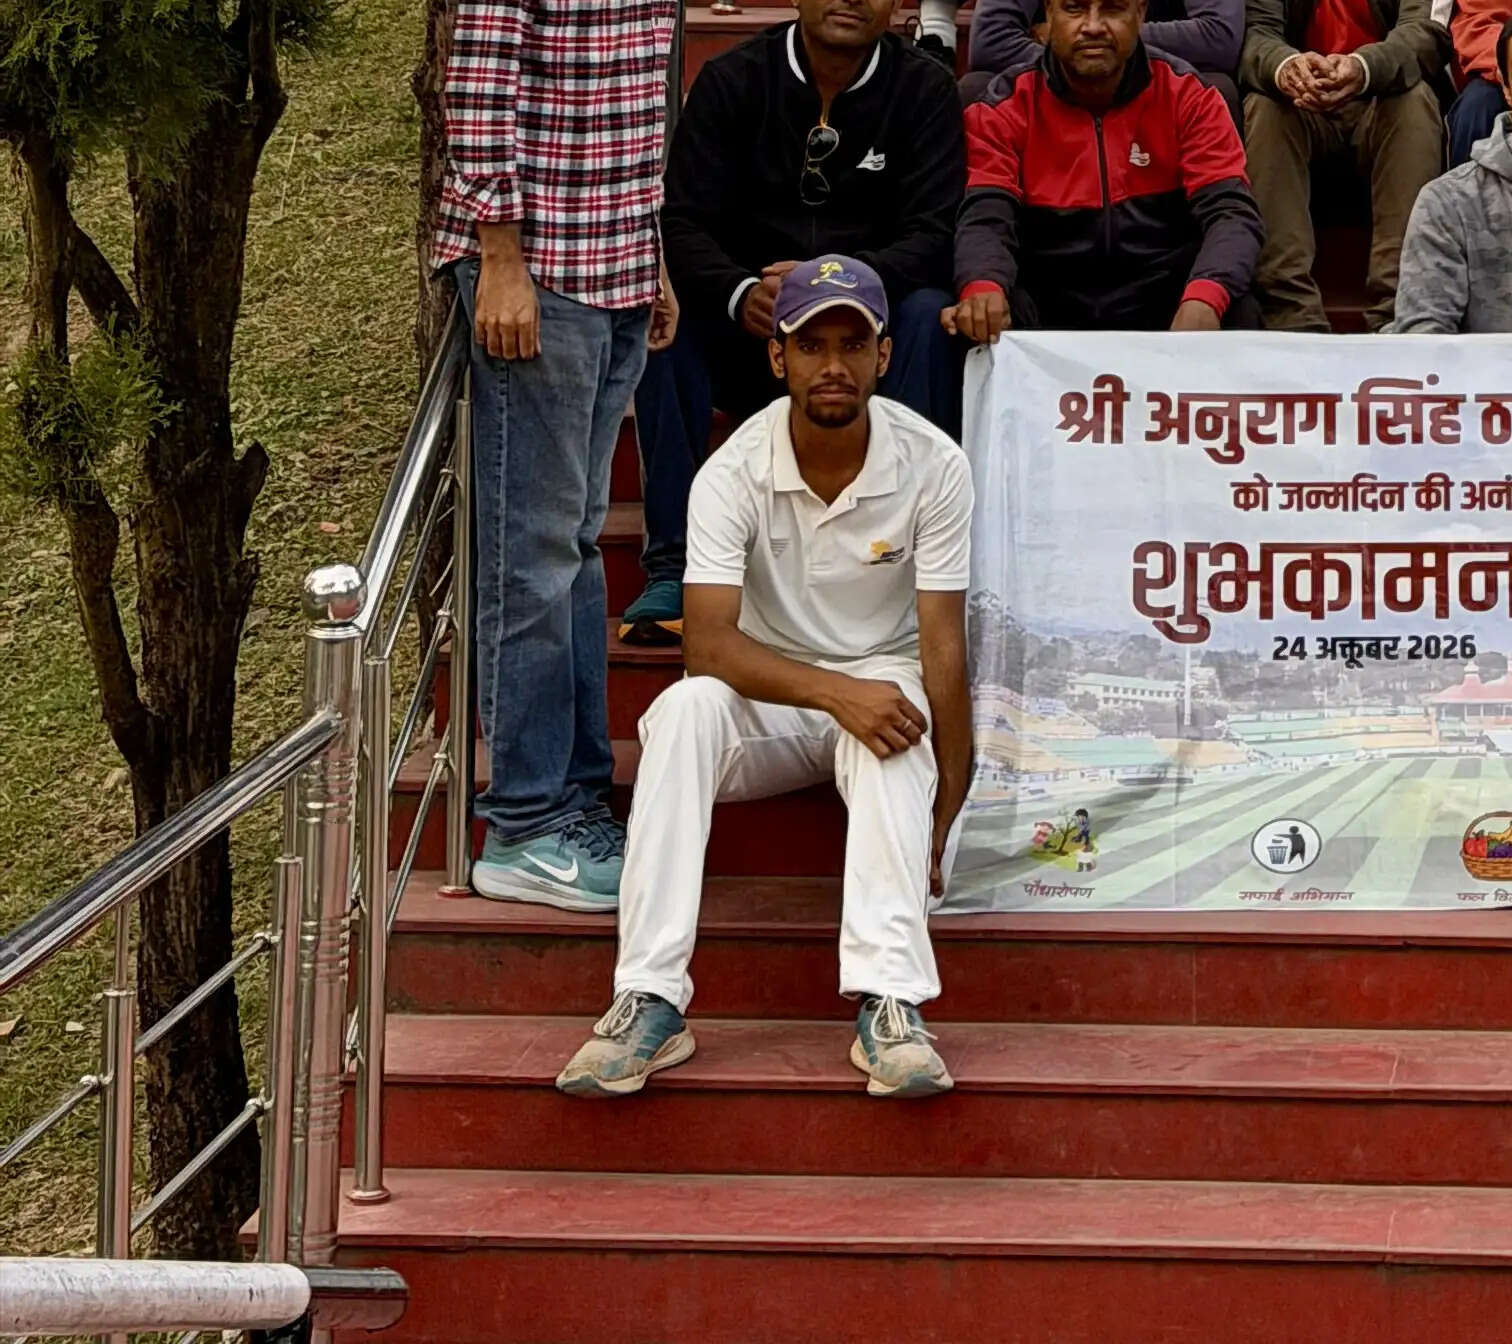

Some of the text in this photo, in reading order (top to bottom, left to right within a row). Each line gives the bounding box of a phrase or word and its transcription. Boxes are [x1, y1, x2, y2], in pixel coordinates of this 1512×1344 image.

[1055, 374, 1131, 445] श्री
[1144, 392, 1343, 464] अनुराग
[1351, 374, 1466, 445] सिंह
[1231, 473, 1273, 512] को
[1276, 473, 1409, 512] जन्मदिन
[1412, 472, 1455, 512] की
[1272, 636, 1308, 661] 24
[1407, 634, 1477, 660] 2026
